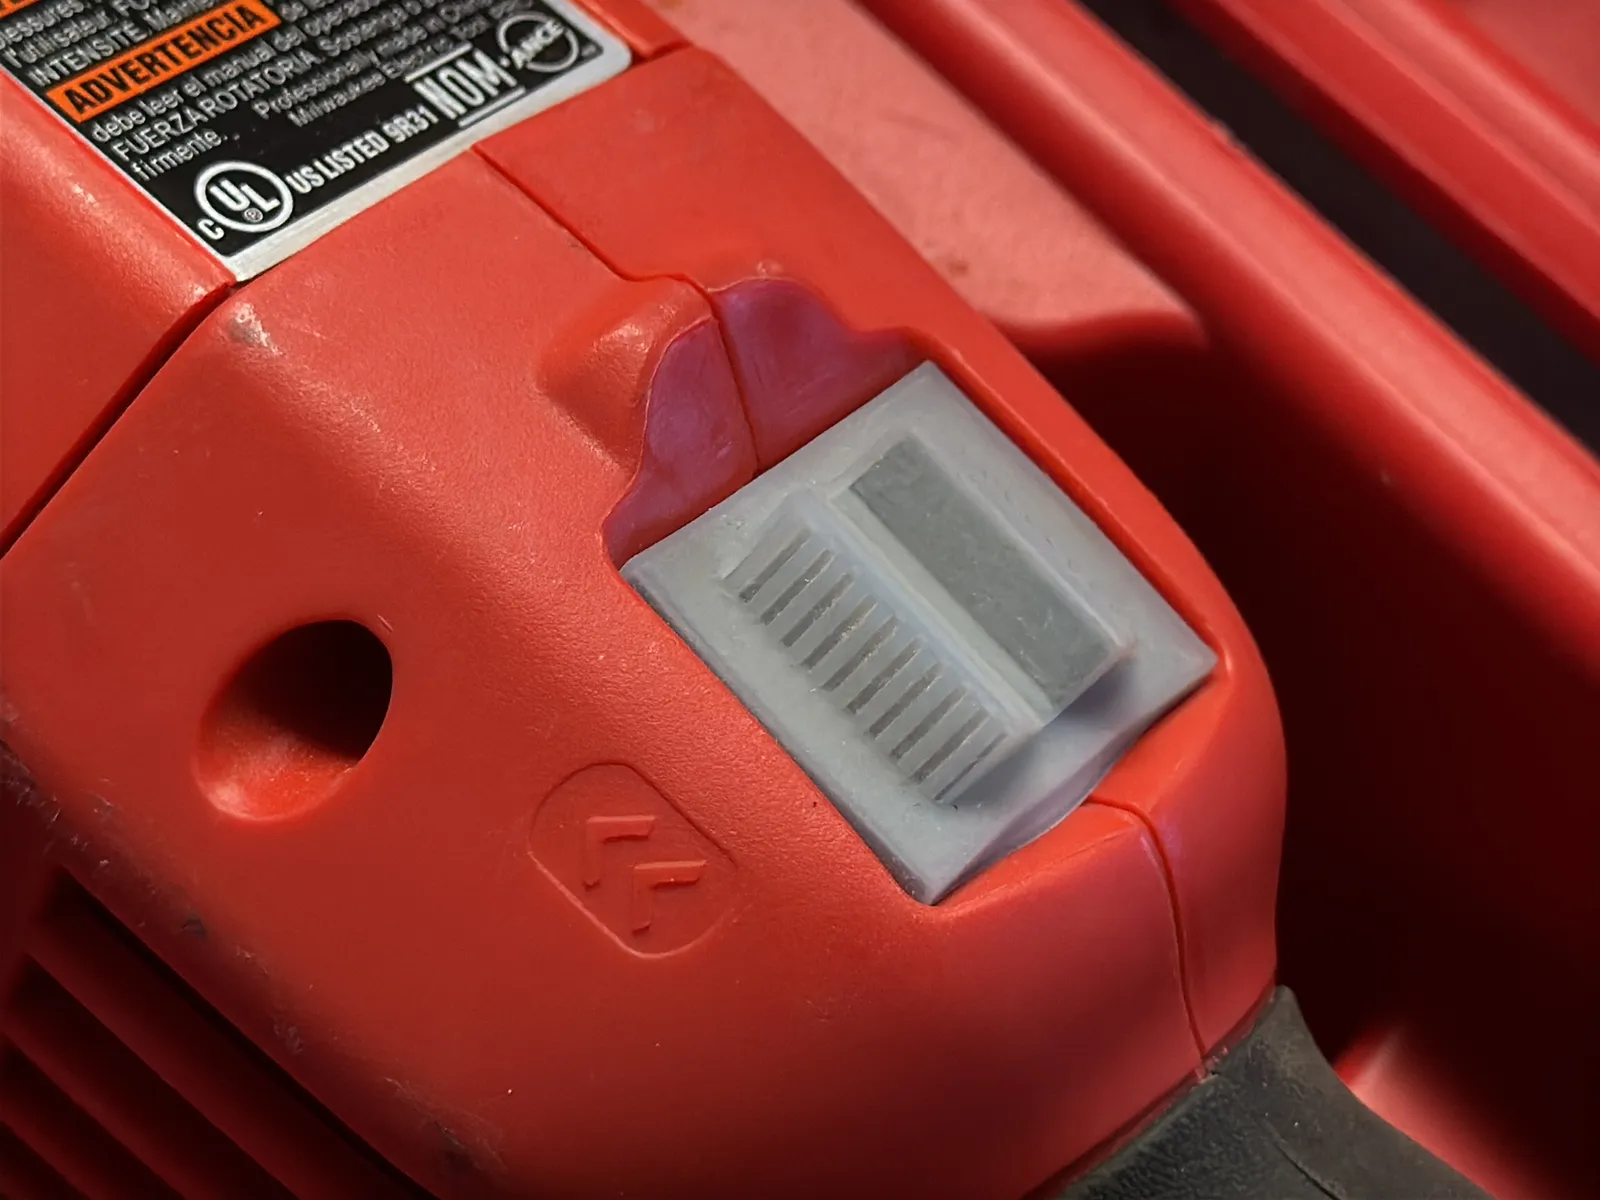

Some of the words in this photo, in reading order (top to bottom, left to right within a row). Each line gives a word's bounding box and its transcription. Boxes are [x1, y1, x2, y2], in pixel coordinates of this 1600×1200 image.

[64, 5, 267, 115] ADVERTENCIA
[92, 109, 146, 142] debe
[138, 88, 184, 117] leer
[182, 75, 207, 97] el
[203, 38, 276, 87] manual
[287, 70, 386, 127] Milwaukee
[413, 48, 518, 120] NOM
[110, 105, 209, 161] FUERZA
[198, 218, 225, 241] C
[284, 164, 325, 194] US
[313, 129, 390, 180] LISTED
[382, 104, 439, 143] 9R31
